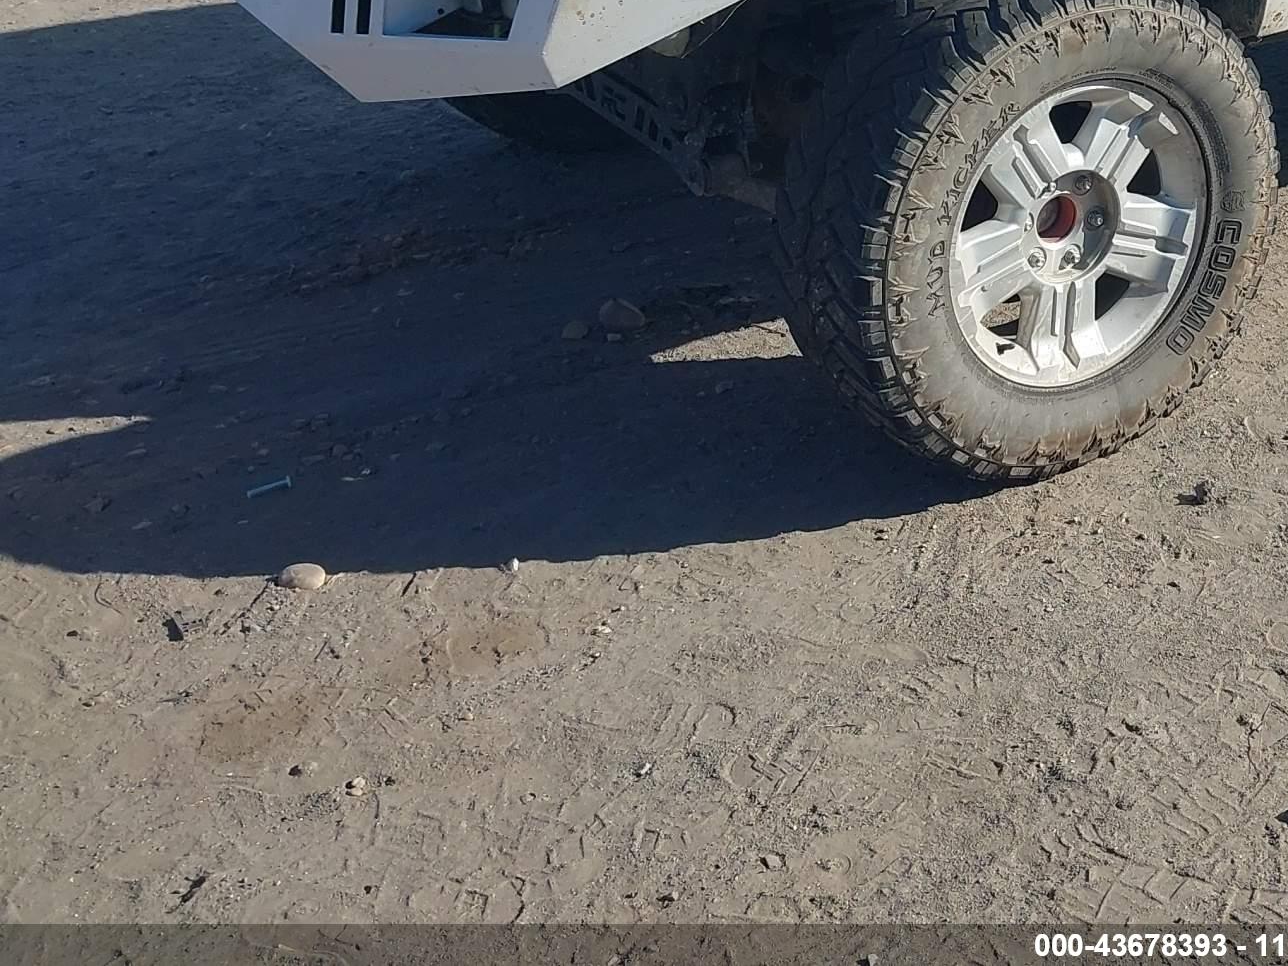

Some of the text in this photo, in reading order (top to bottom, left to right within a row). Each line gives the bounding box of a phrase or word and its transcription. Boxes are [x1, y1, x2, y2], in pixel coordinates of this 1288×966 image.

[926, 101, 1020, 317] MUD KICKER
[1165, 219, 1243, 356] COSMO
